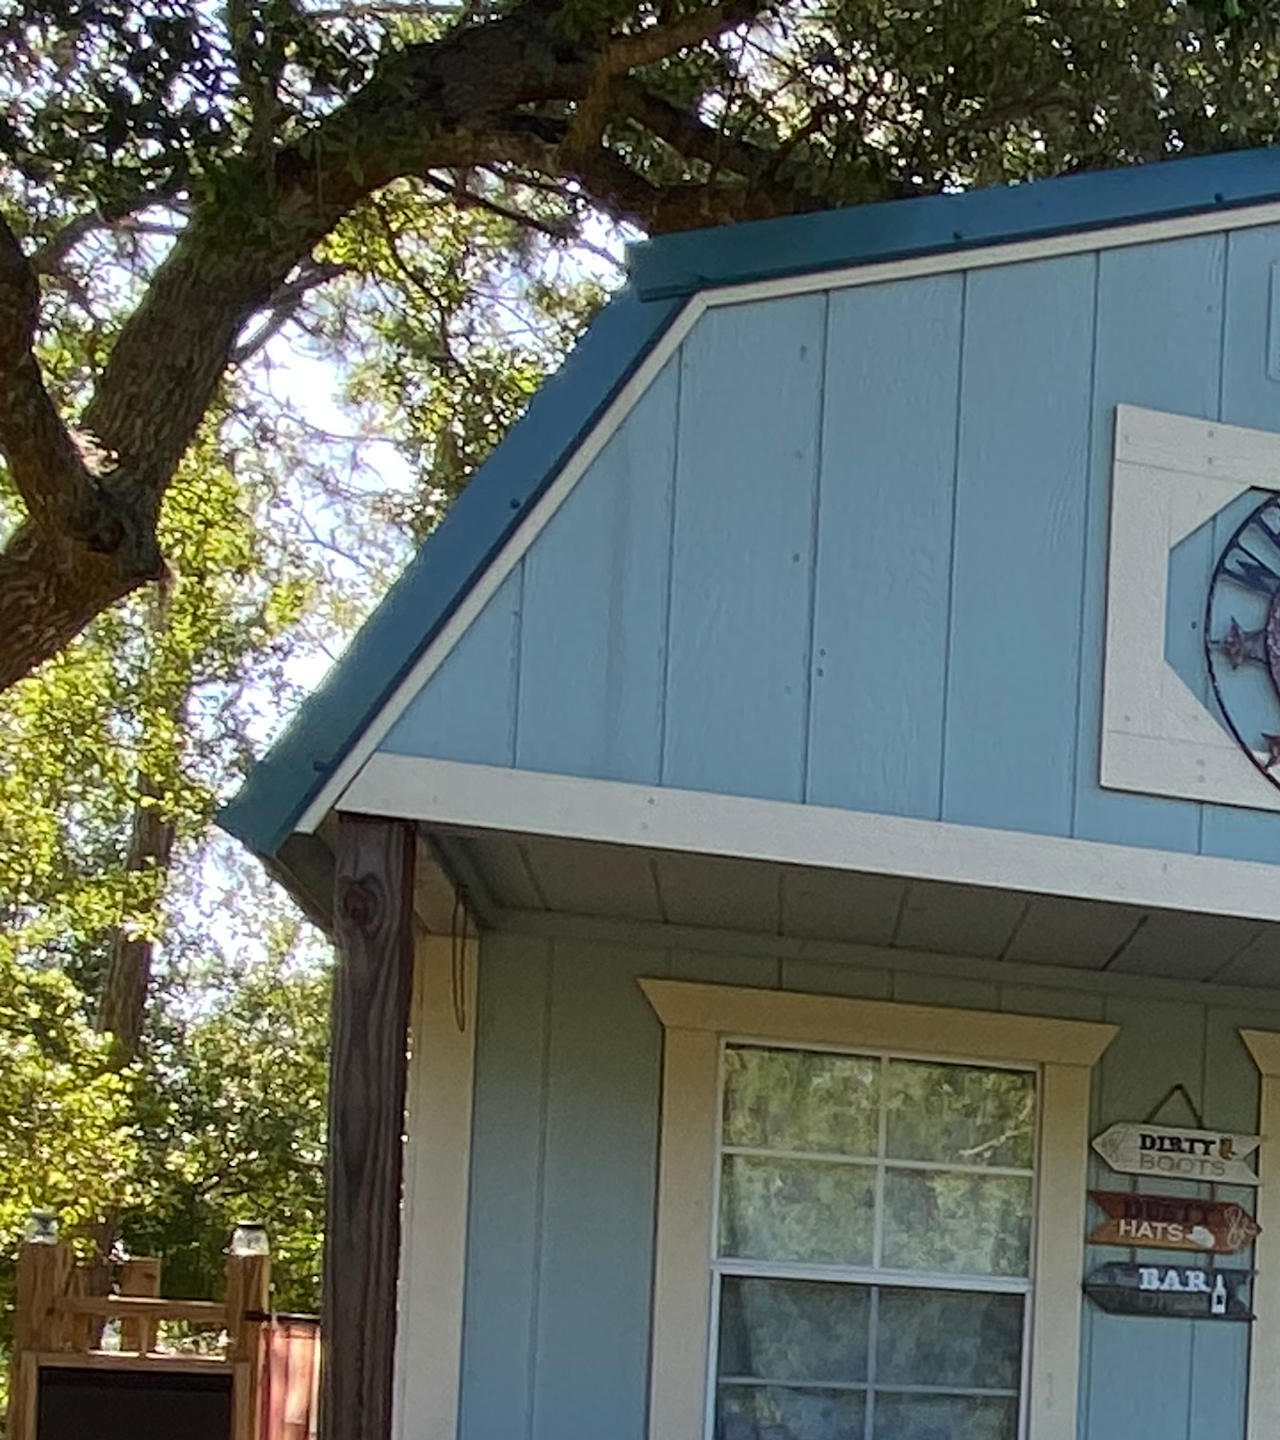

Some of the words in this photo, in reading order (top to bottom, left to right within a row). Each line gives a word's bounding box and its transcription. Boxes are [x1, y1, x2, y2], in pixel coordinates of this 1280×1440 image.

[1139, 1134, 1216, 1156] DIRTY
[1139, 1153, 1226, 1177] BOOTS
[1119, 1219, 1184, 1242] HATS
[1138, 1267, 1212, 1293] BAR
